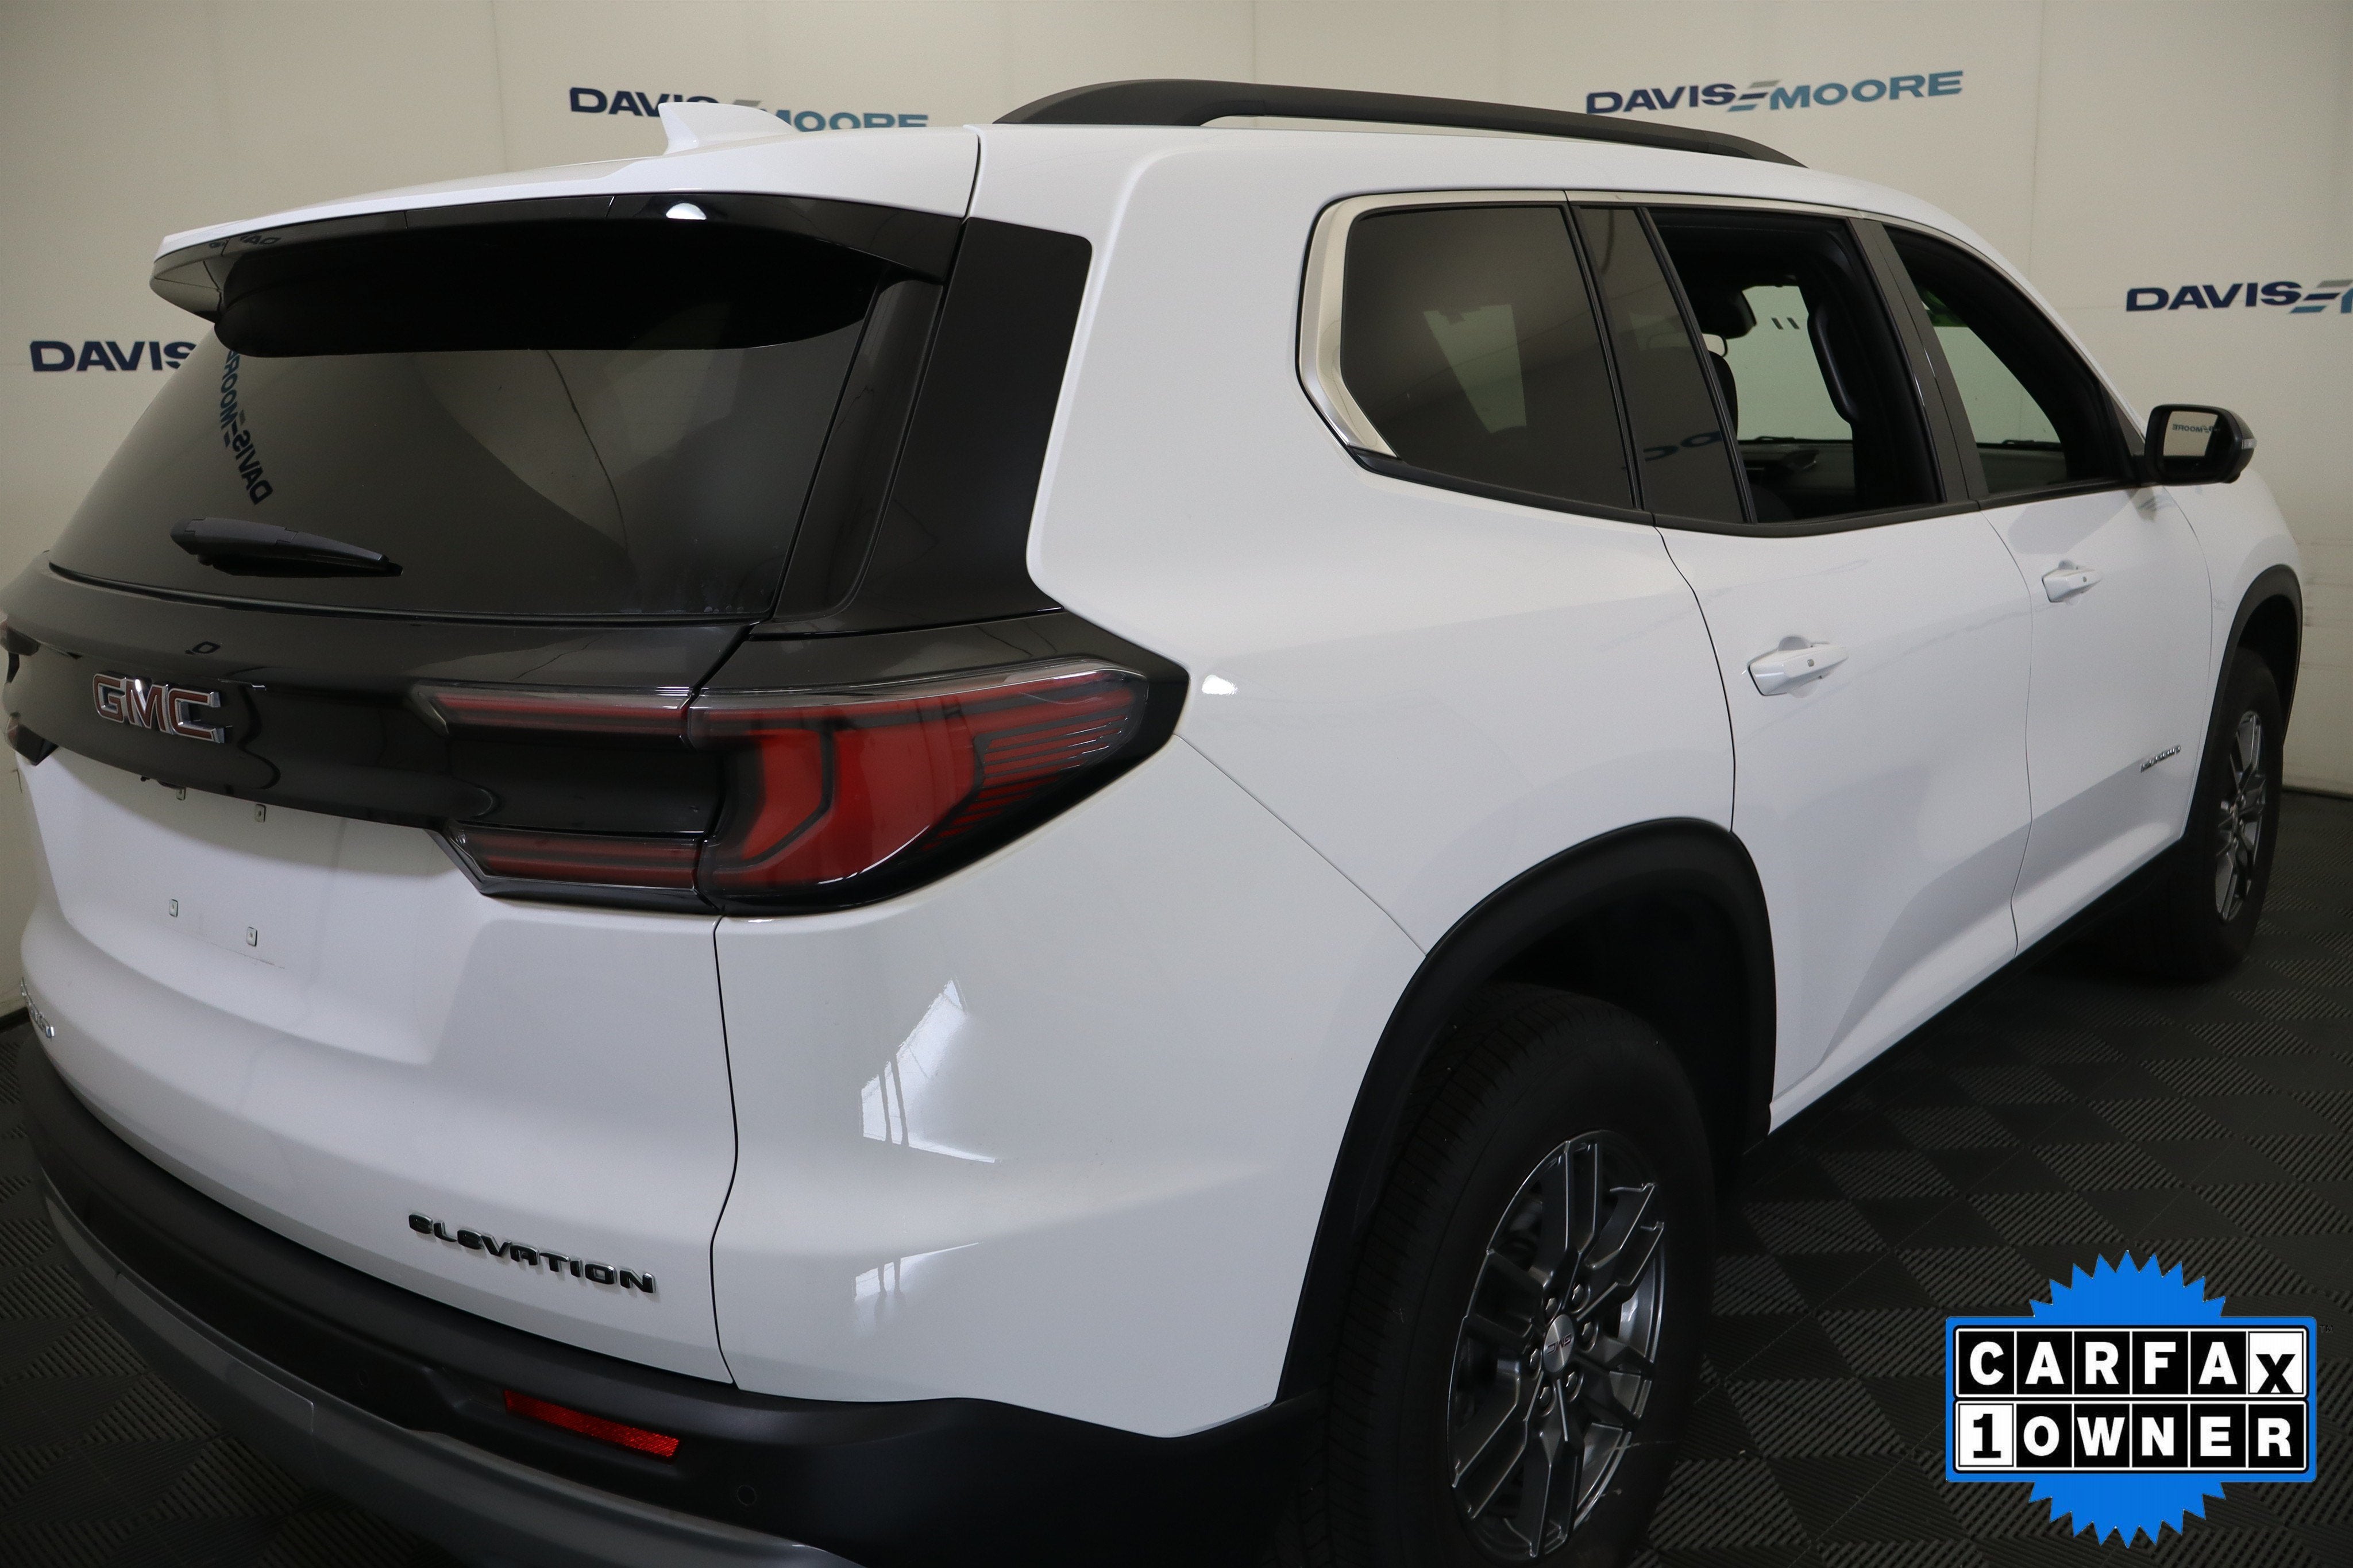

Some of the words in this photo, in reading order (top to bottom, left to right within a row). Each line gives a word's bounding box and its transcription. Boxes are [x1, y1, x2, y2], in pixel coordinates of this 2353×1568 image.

[569, 87, 720, 118] DAV
[1586, 83, 1736, 115] DAVIS
[1769, 70, 1963, 111] MOORE
[2126, 281, 2302, 312] DAVIS
[30, 341, 197, 372] DAVIS
[93, 673, 226, 743] GMC
[408, 1212, 656, 1293] ELEVATION
